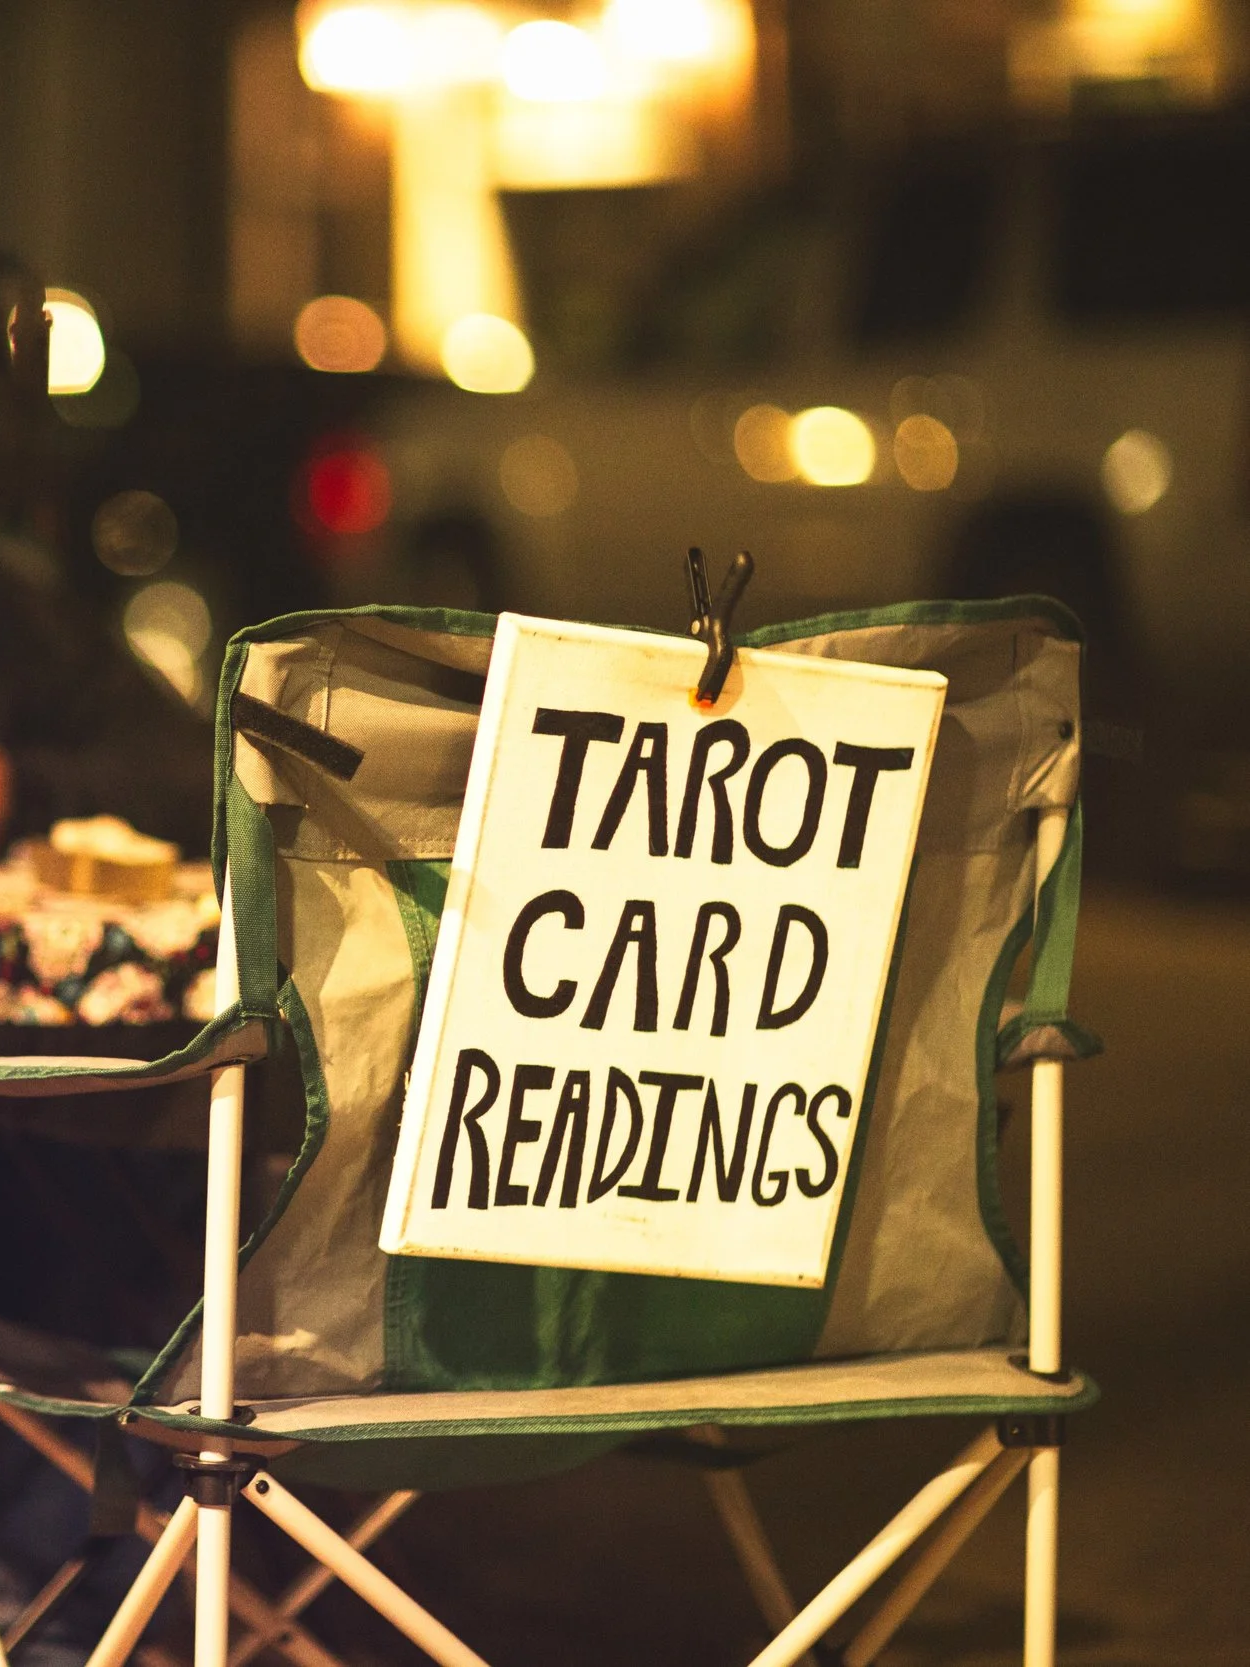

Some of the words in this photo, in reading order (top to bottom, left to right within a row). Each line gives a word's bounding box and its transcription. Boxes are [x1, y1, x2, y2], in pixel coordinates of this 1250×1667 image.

[532, 708, 915, 868] TAROT
[503, 889, 828, 1036] CARD
[431, 1048, 852, 1210] READINGS
